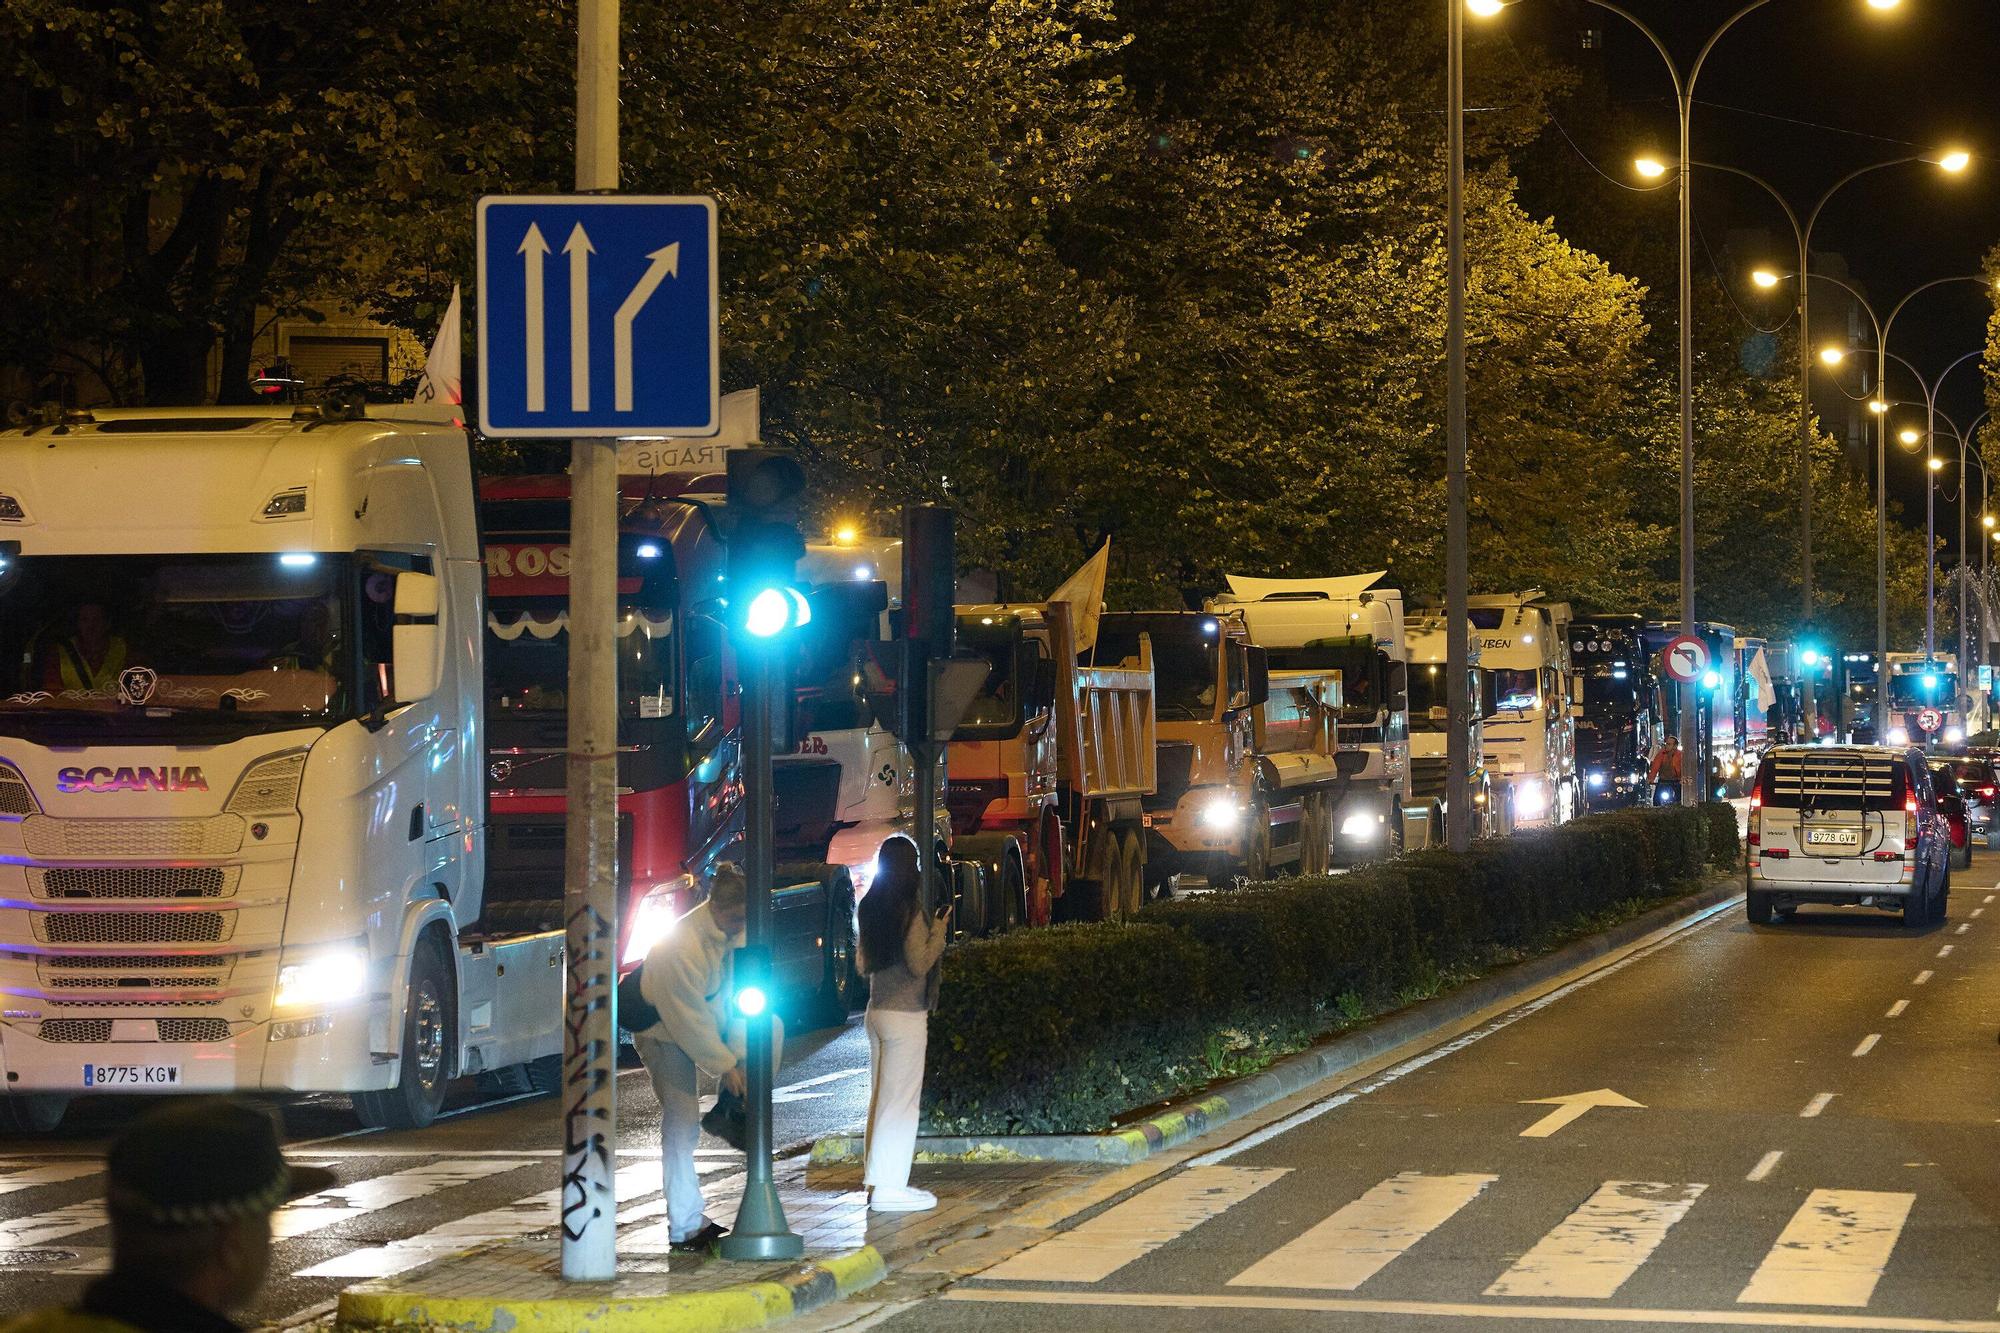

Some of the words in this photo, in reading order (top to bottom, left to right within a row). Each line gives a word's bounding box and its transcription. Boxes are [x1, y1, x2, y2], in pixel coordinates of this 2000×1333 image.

[56, 767, 209, 793] SCANIA
[1813, 832, 1836, 842] 9778
[96, 1067, 139, 1083] 8775
[145, 1067, 177, 1083] KGW
